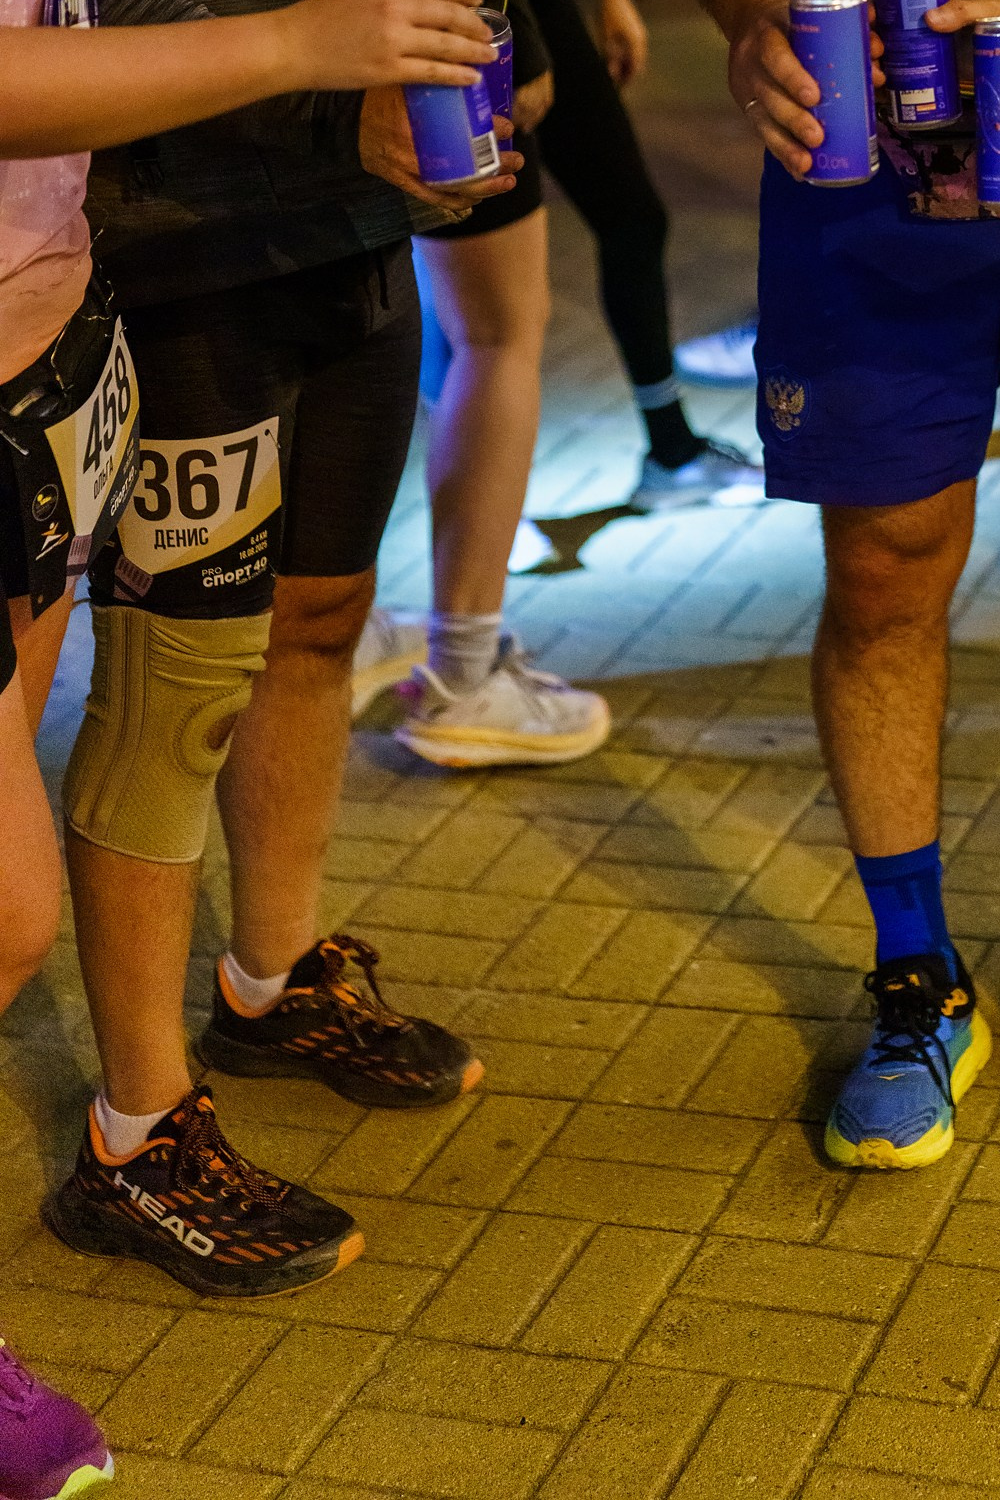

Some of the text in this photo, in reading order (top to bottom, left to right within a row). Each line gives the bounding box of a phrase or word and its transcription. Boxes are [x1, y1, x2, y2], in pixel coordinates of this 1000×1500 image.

[83, 345, 131, 475] 458
[133, 435, 259, 522] 367
[153, 526, 209, 551] ДЕНИС
[201, 566, 223, 577] PRO
[202, 563, 253, 588] СПОРТ
[253, 556, 268, 571] 40
[113, 1170, 215, 1257] HEAD
